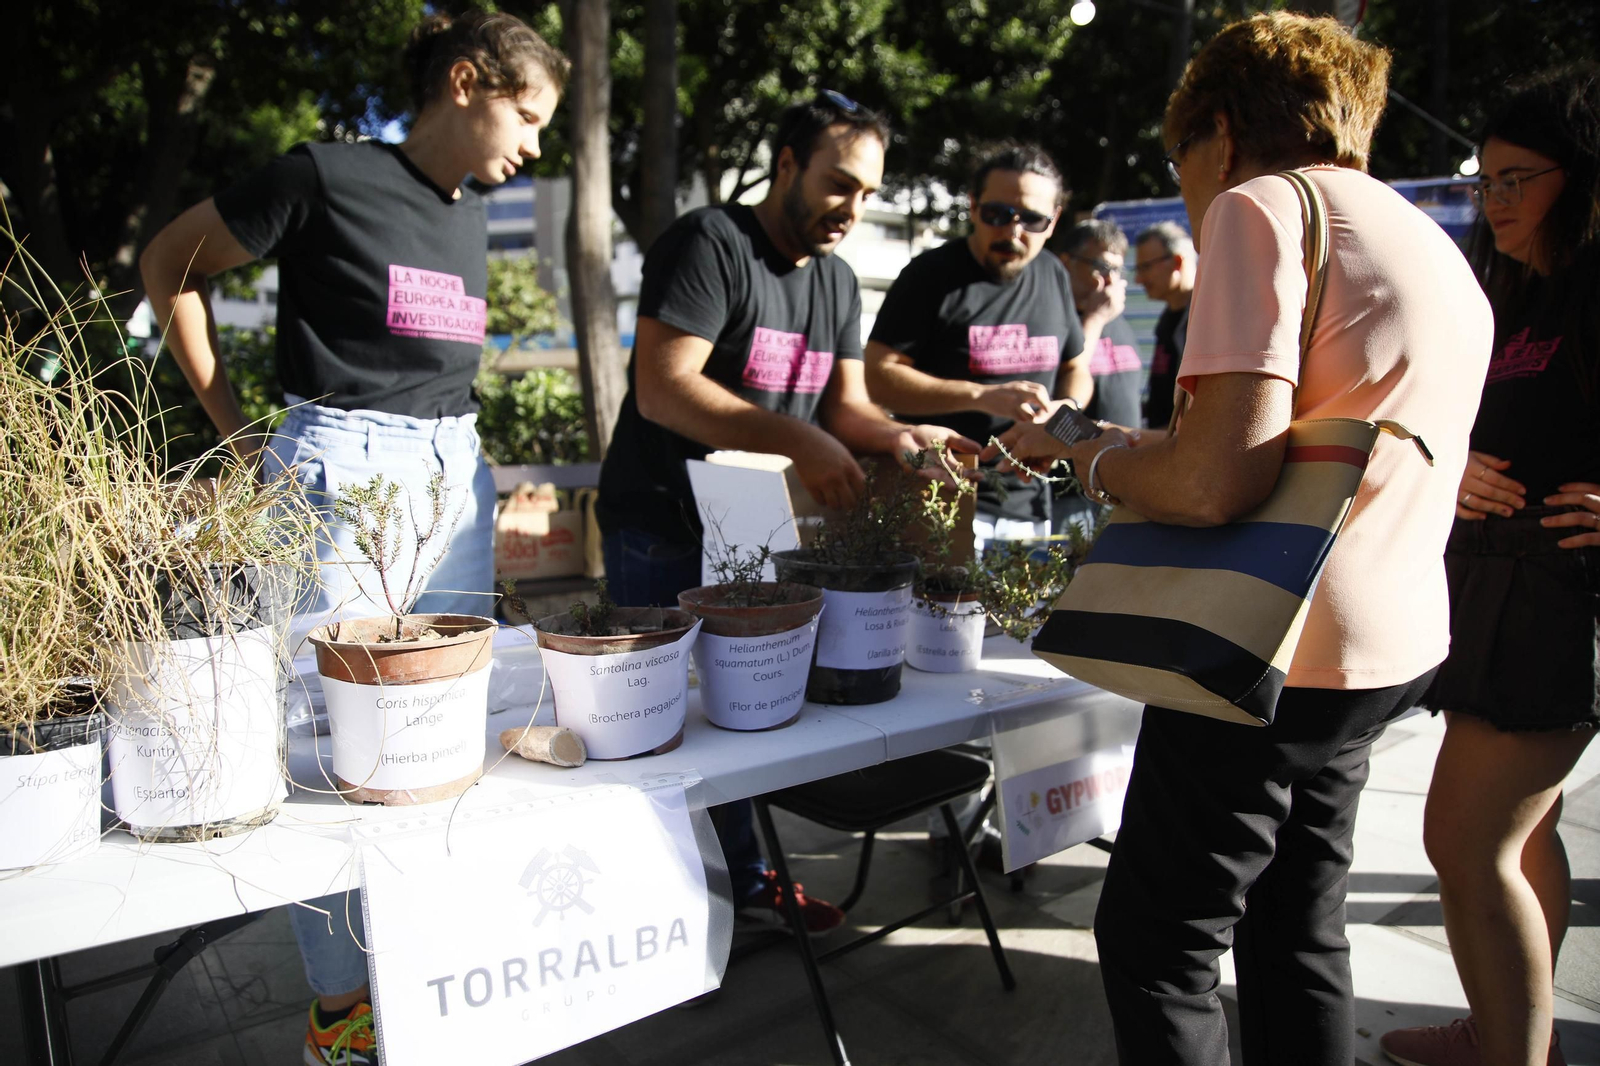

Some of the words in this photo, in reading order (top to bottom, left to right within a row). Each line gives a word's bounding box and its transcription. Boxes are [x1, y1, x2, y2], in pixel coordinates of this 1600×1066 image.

[394, 270, 413, 284] LA
[420, 275, 460, 292] NOCHE
[394, 290, 455, 309] EUROPEA
[460, 301, 472, 313] DE
[865, 621, 884, 631] Losa
[886, 620, 893, 630] &
[729, 633, 801, 654] Helianthemum
[714, 656, 774, 669] squamatum
[776, 651, 791, 664] (L.)
[949, 648, 960, 657] de
[589, 661, 642, 676] Santolina
[645, 650, 680, 668] viscosa
[627, 676, 650, 688] Lag.
[752, 669, 785, 682] Cours.
[376, 697, 408, 710] Coris
[412, 687, 466, 710] hispanica
[729, 701, 752, 713] (Flor
[754, 701, 768, 711] de
[405, 711, 444, 727] Lange
[588, 708, 641, 725] (Brochera
[136, 744, 175, 758] Kunth
[380, 751, 428, 766] (Hierba
[431, 740, 467, 763] pincel)
[16, 773, 58, 790] Stipa
[1045, 765, 1127, 815] GYPWOR
[133, 785, 190, 802] (Esparto)
[426, 917, 690, 1018] TORRALBA
[521, 983, 617, 1022] GRUPO
